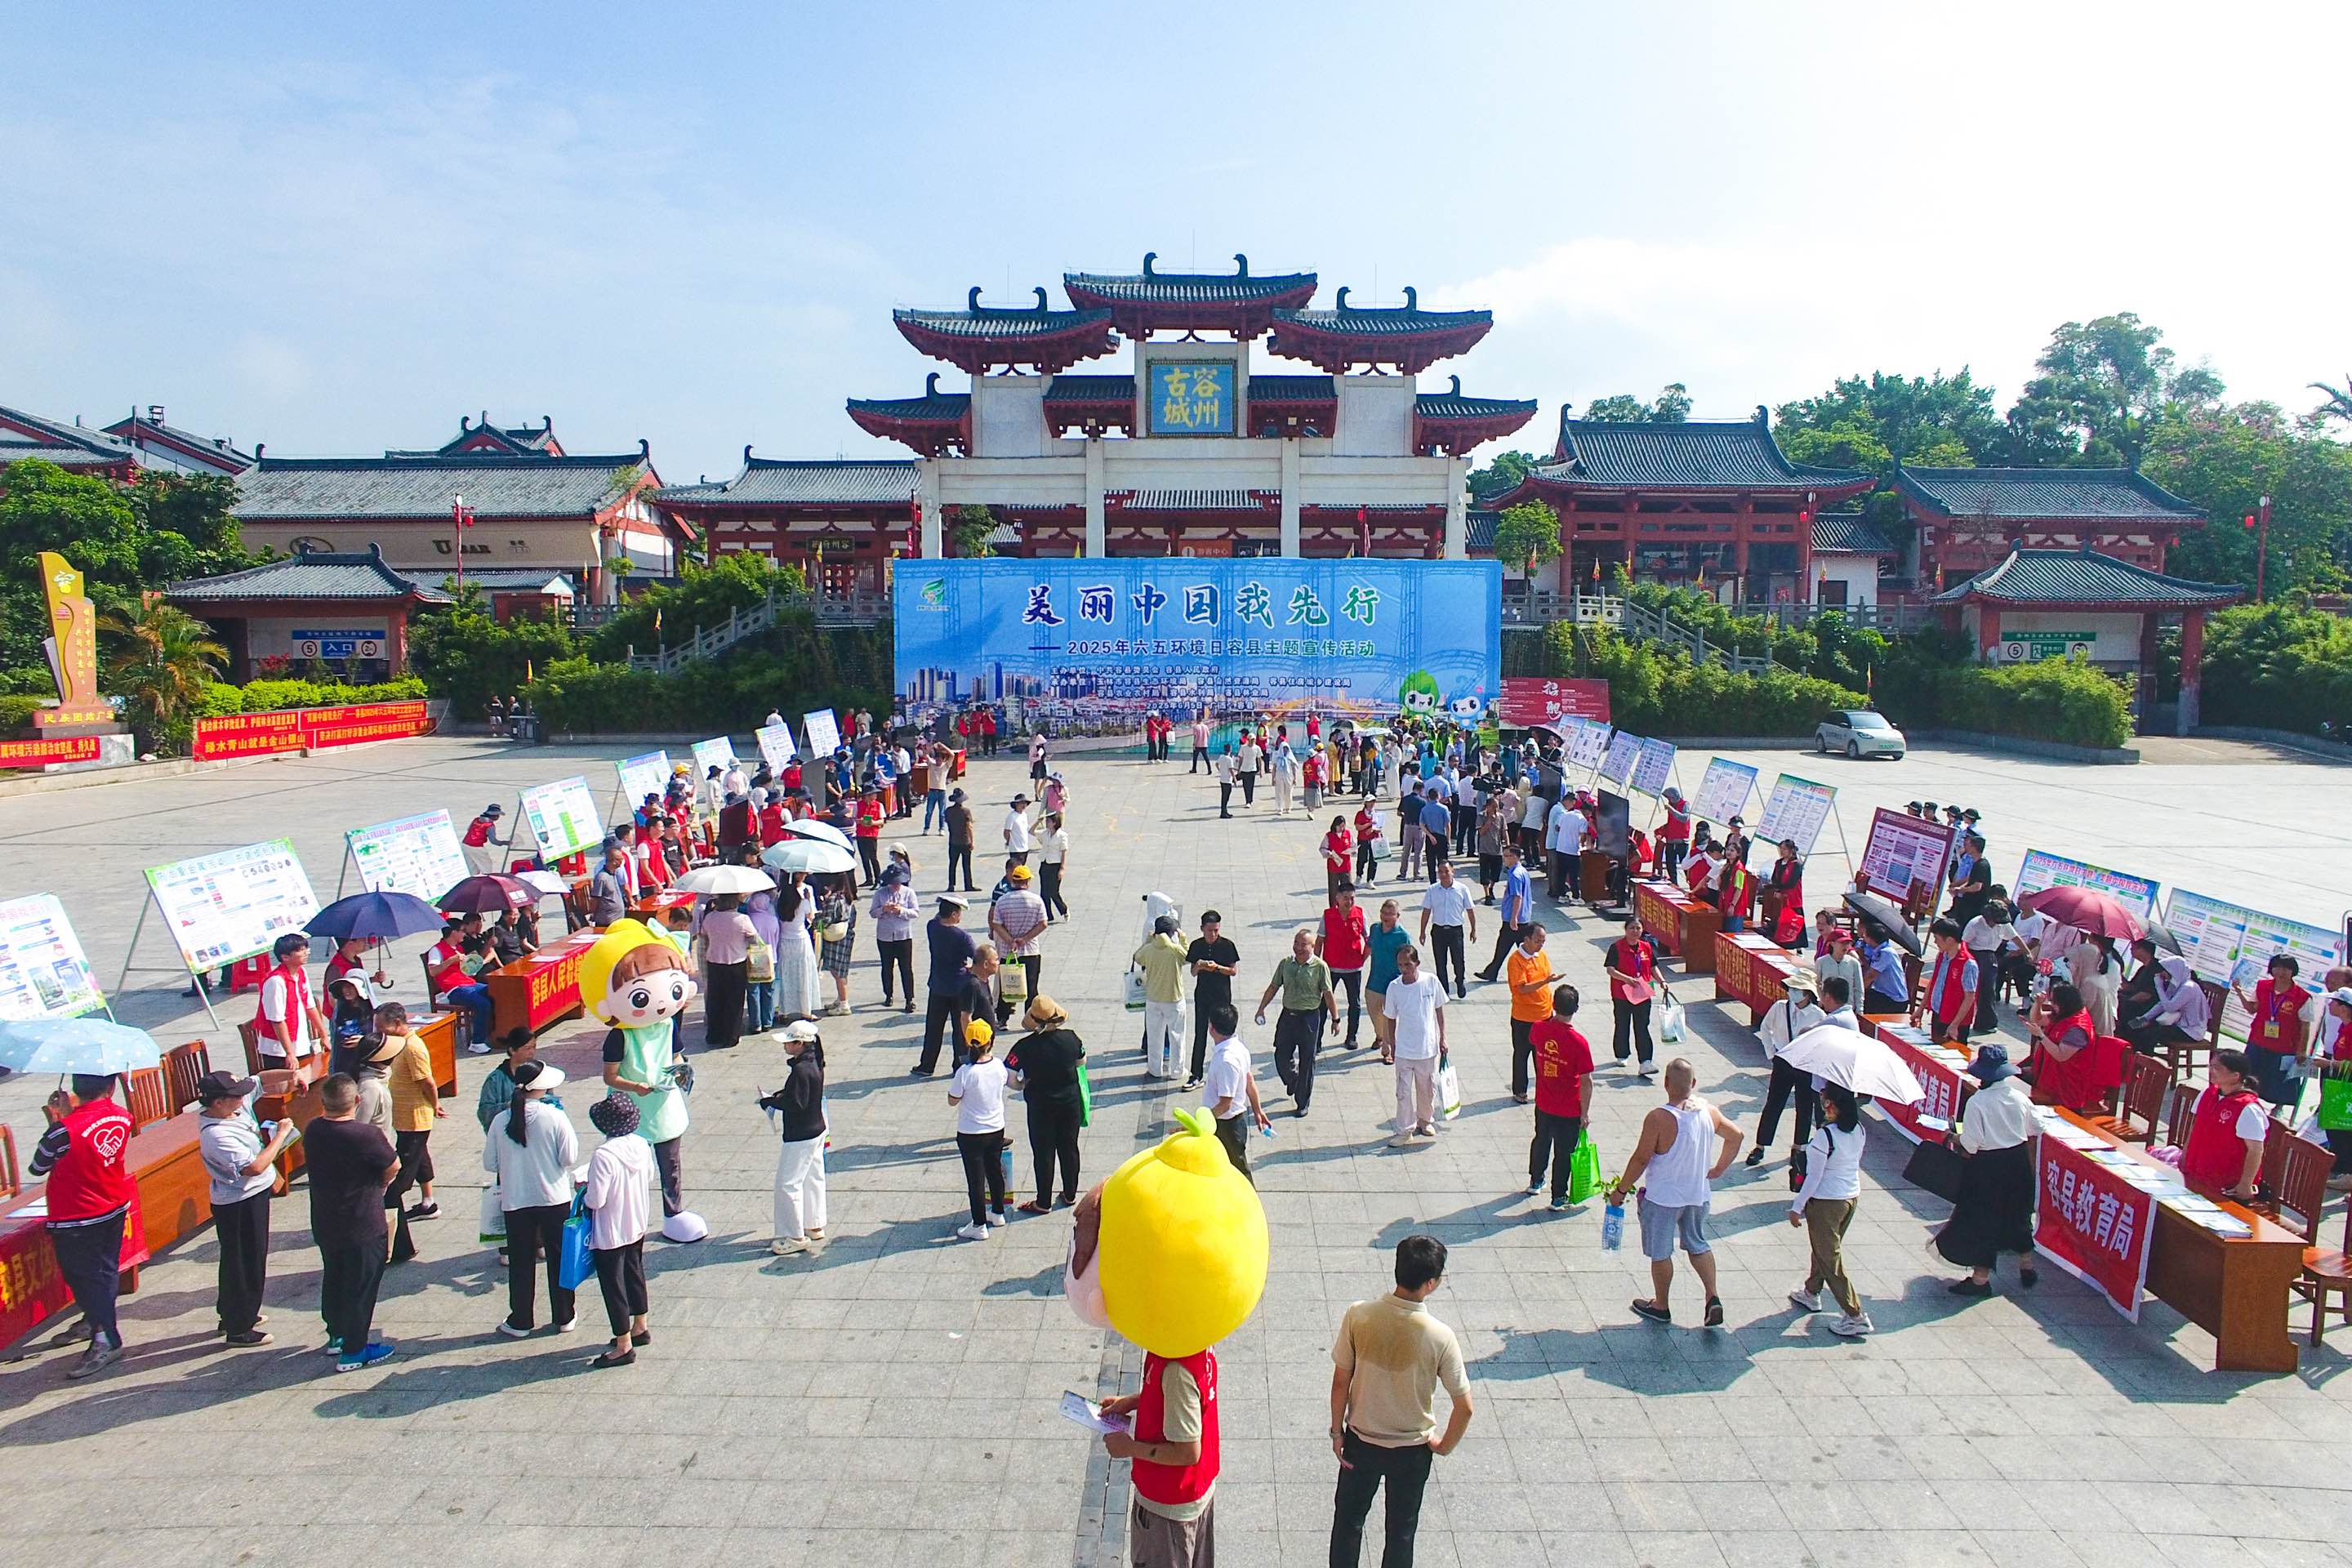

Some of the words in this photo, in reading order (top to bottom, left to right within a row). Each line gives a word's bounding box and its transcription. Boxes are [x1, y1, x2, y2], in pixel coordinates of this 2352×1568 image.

[1022, 582, 1379, 628] 美丽中国我先行
[306, 644, 313, 653] 5
[327, 643, 353, 652] 入口
[1165, 666, 1219, 675] 容县人民政府
[2047, 1159, 2136, 1261] 容县教育局
